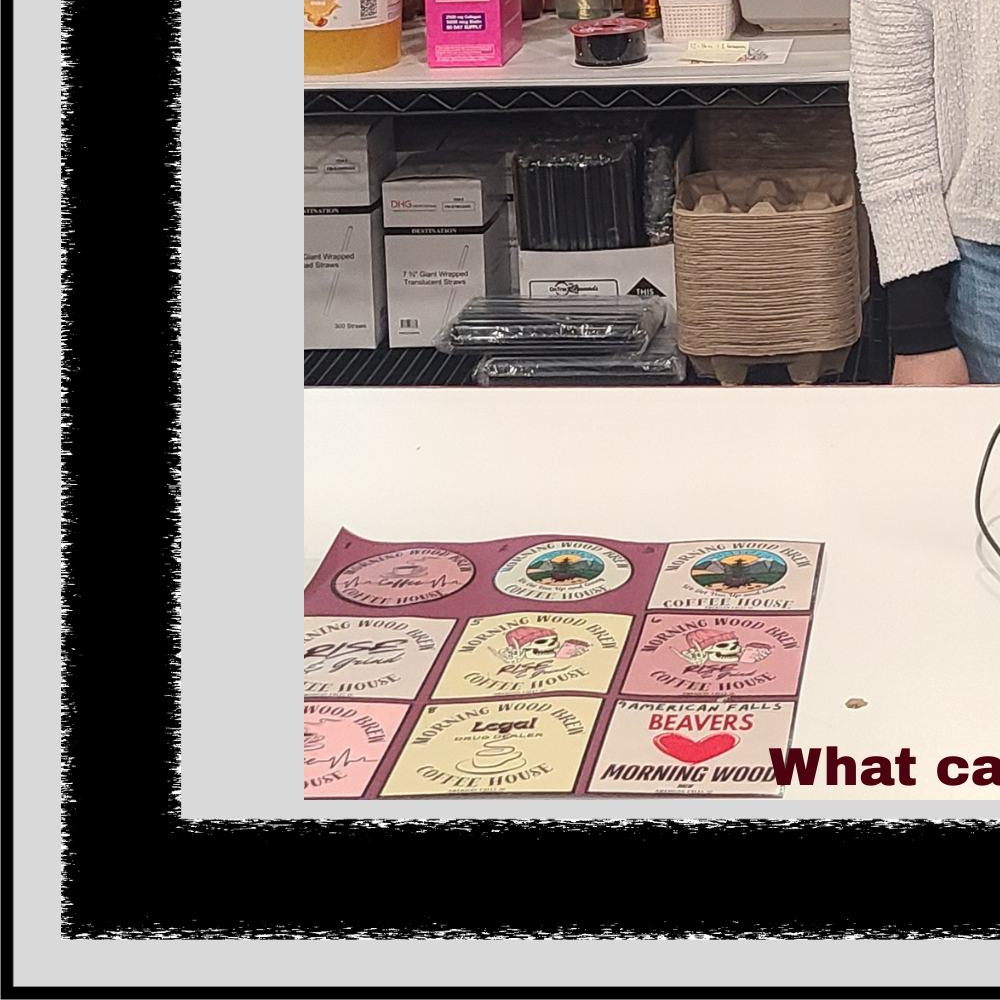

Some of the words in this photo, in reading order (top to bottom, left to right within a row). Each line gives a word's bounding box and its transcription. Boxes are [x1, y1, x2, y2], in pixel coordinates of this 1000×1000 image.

[391, 200, 412, 209] DHG
[323, 253, 355, 262] Wrapped
[440, 271, 469, 279] Wrapped
[636, 288, 655, 296] THIS
[409, 549, 451, 557] WOOD
[500, 543, 555, 573] MORNING
[561, 541, 603, 551] WOOD
[602, 550, 629, 569] BREW
[664, 543, 726, 573] MORNING
[732, 542, 780, 550] WOOD
[780, 547, 812, 568] BREW
[397, 589, 446, 604] HOUSE
[504, 585, 558, 599] COFFEE
[562, 585, 609, 600] HOUSE
[663, 598, 731, 608] COFFEE
[737, 598, 795, 609] HOUSE
[358, 620, 409, 631] WOOD
[405, 628, 436, 651] BREW
[458, 617, 530, 654] MORNING
[536, 615, 588, 627] WOOD
[586, 624, 619, 650] BREW
[640, 619, 708, 653] MORNING
[714, 617, 766, 630] WOOD
[765, 626, 800, 650] BREW
[304, 639, 409, 659] RISE
[495, 660, 554, 676] RISE
[682, 663, 739, 675] RISE
[338, 673, 402, 693] HOUSE
[463, 672, 525, 691] COFFEE
[530, 668, 590, 690] HOUSE
[650, 671, 711, 692] COFFEE
[719, 671, 777, 691] HOUSE
[627, 702, 718, 712] AMERICAN
[725, 702, 782, 712] FALLS
[304, 705, 358, 718] WOOD
[353, 715, 386, 743] BREW
[411, 706, 490, 746] MORNING
[498, 702, 553, 712] WOOD
[550, 708, 586, 736] BREW
[471, 717, 539, 734] Legal
[648, 713, 755, 731] BEAVERS
[493, 732, 544, 740] DEALER
[416, 765, 482, 788] COFFEE
[488, 762, 555, 787] HOUSE
[600, 763, 710, 783] MORNING
[711, 765, 776, 783] WOOD
